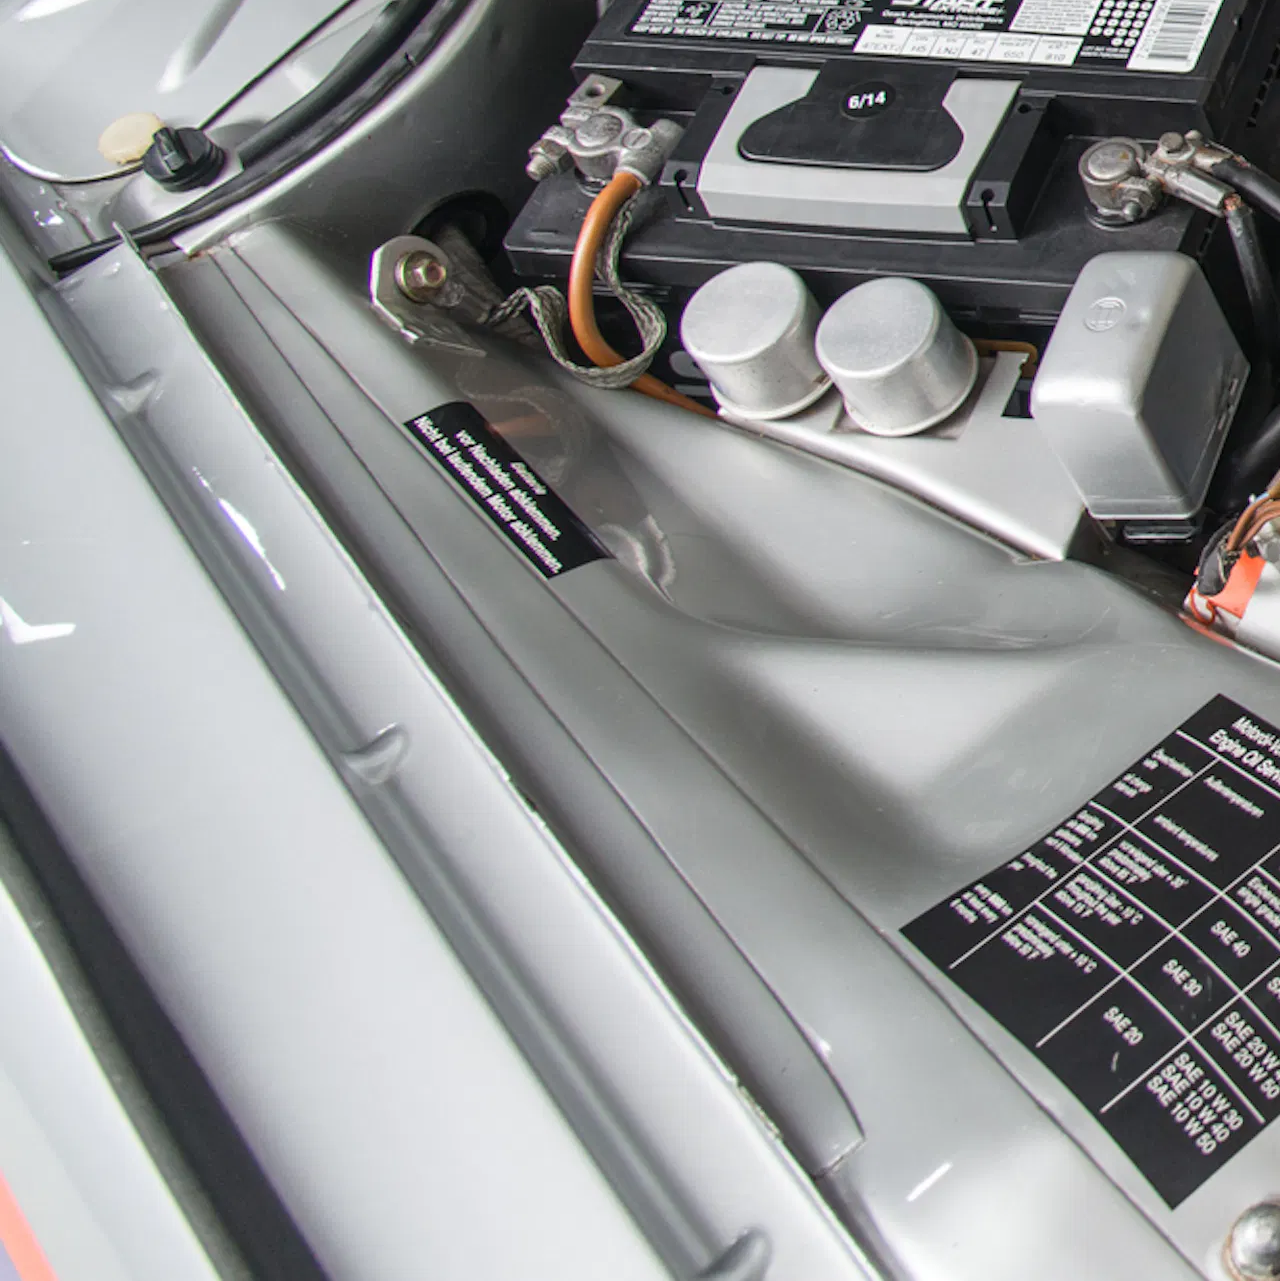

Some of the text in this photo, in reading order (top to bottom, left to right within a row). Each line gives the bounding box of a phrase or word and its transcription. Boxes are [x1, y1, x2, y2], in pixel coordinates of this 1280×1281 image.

[848, 90, 887, 110] 6/14
[414, 416, 563, 574] Nicht bei laufendem Motor abklemmen.
[455, 429, 562, 542] vor Nachladen abklemmen.
[1208, 728, 1250, 759] Engine
[1241, 750, 1265, 768] Oil
[1210, 920, 1251, 958] SAE 40
[1162, 958, 1203, 997] SAE 30
[1103, 1006, 1144, 1046] SAE 20
[1223, 1011, 1255, 1042] SAE
[1245, 1036, 1268, 1057] 20
[1211, 1022, 1280, 1099] SAE 20 W 50
[1146, 1074, 1217, 1155] SAE 10 W 50
[1158, 1063, 1230, 1143] SAE 10 W 40
[1172, 1052, 1244, 1131] SAE 10 W 30
